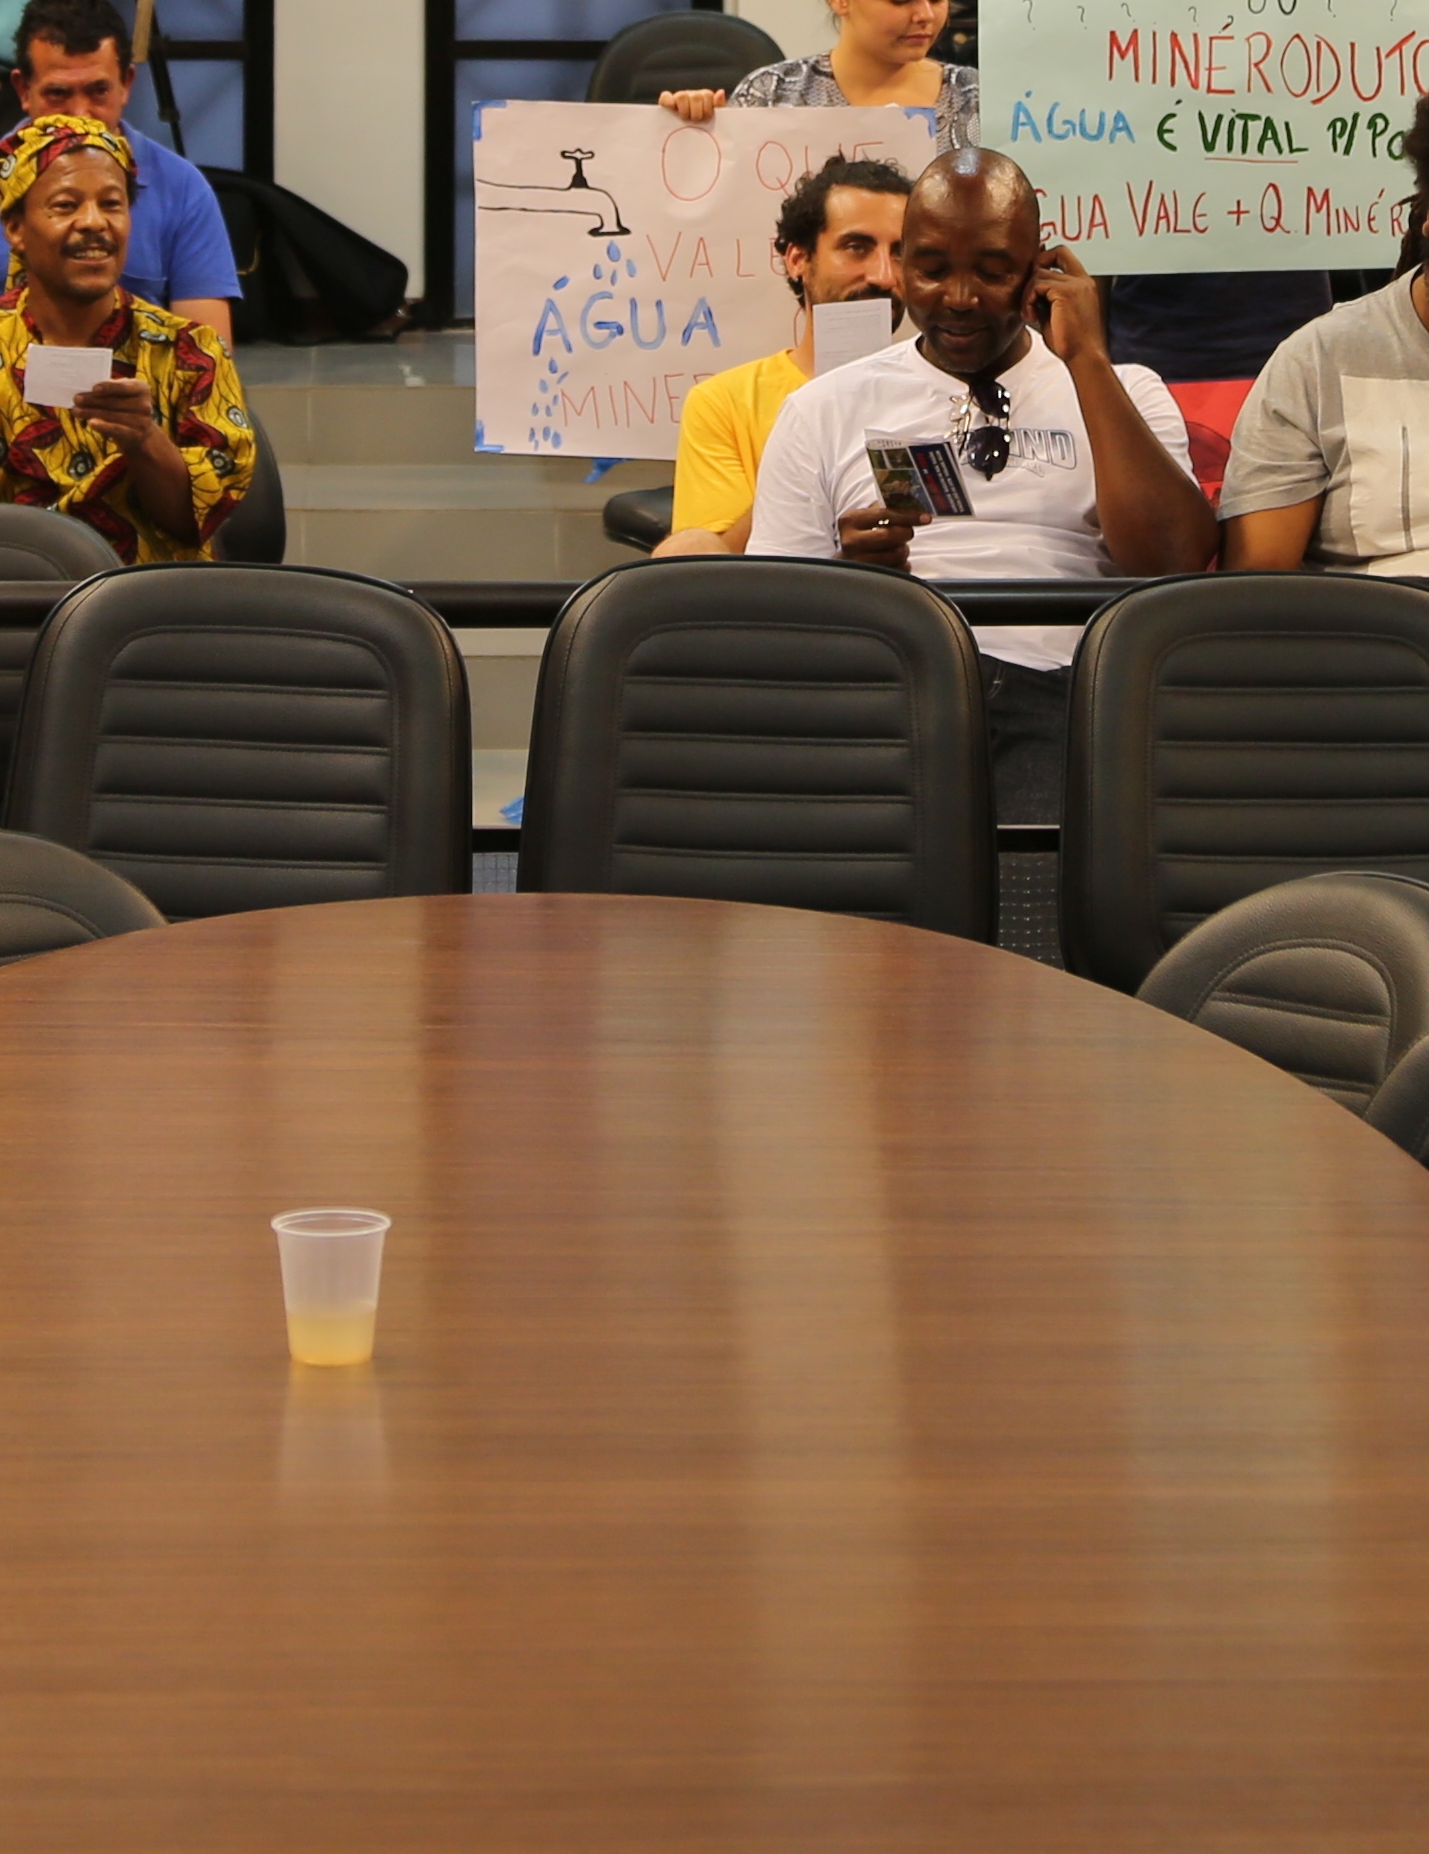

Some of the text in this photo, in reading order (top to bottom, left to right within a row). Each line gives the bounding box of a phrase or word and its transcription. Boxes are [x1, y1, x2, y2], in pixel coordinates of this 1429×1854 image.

[1009, 91, 1408, 161] ÁGUA É VITAL P/ PO
[661, 125, 722, 202] O
[1036, 187, 1111, 242] GUA
[1126, 180, 1209, 237] VALE
[1227, 199, 1250, 226] +
[1305, 185, 1411, 238] MINÉR
[532, 274, 722, 357] ÁGUA
[559, 372, 715, 430] MINE
